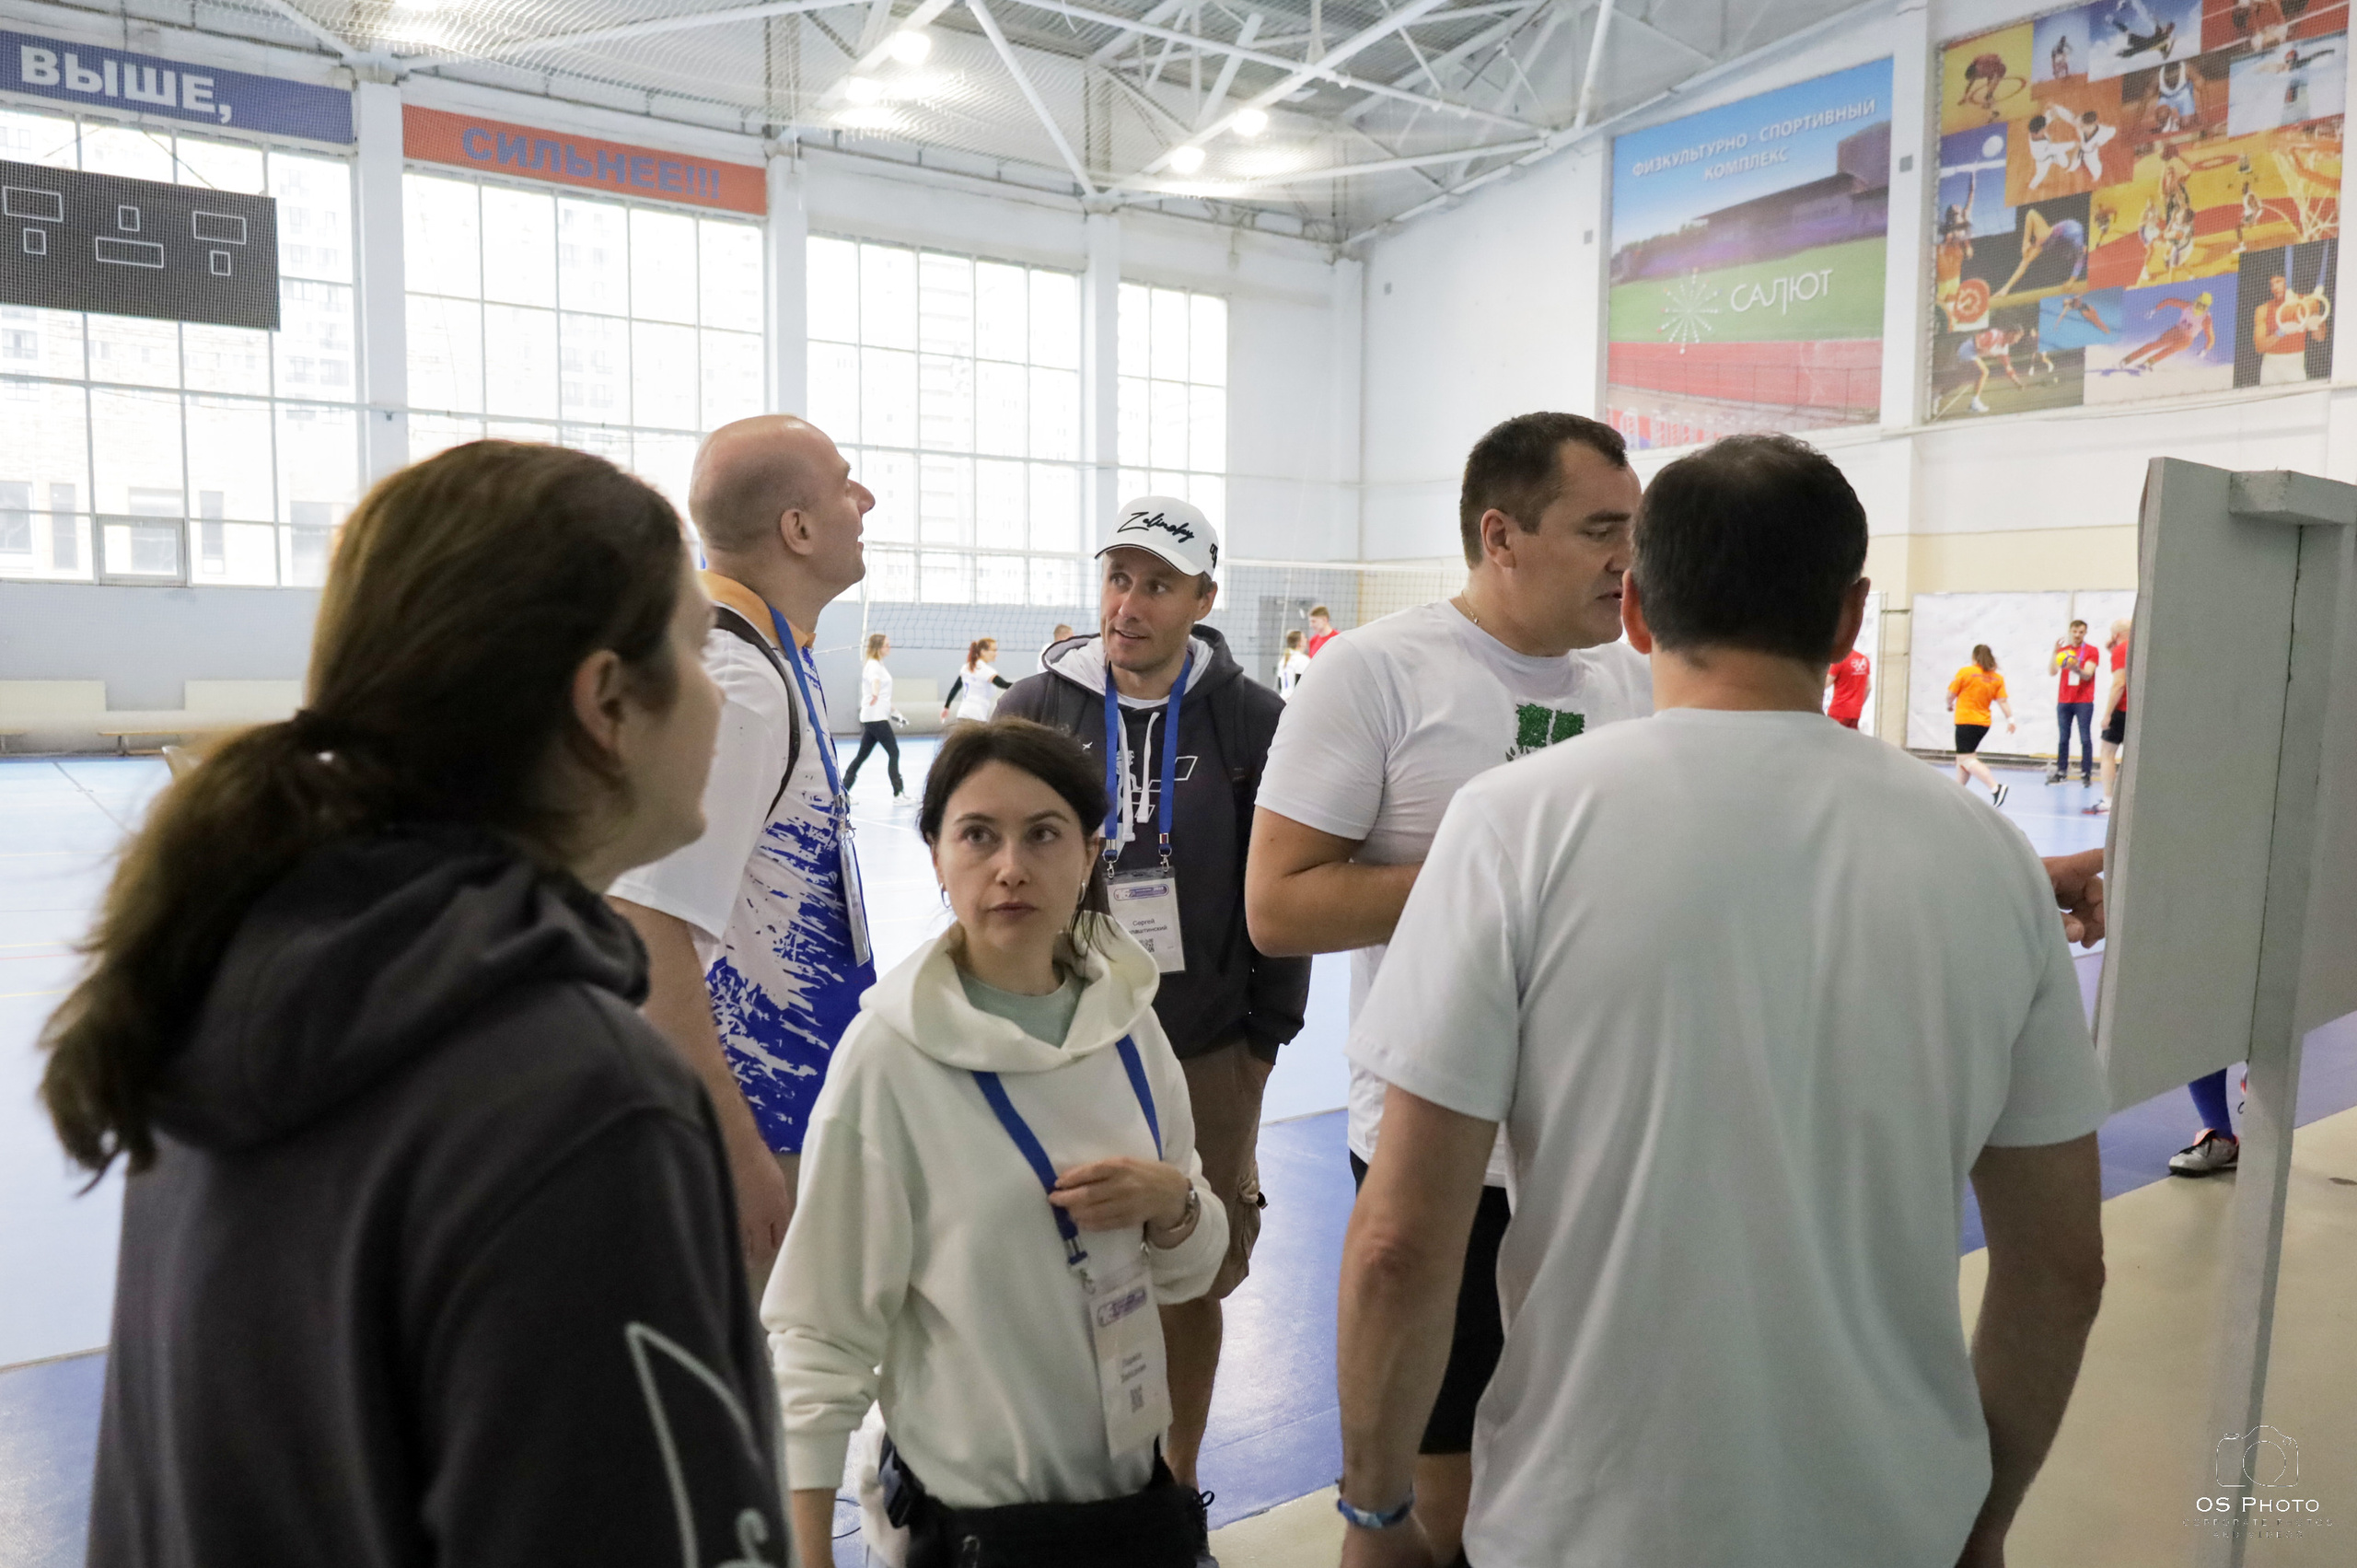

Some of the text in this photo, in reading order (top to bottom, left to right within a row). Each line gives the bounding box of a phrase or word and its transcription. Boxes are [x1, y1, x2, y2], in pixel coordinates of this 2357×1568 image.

[20, 45, 232, 124] ВЫШЕ,
[461, 126, 720, 200] СИЛЬНЕЕ!!!
[1631, 133, 1748, 177] ФИЗКУЛЬТУРНО
[1759, 98, 1875, 143] СПОРТИВНЫЙ
[1703, 146, 1789, 181] КОМПЛЕКС
[1730, 269, 1833, 315] САЛЮТ
[1132, 918, 1155, 926] Сергей
